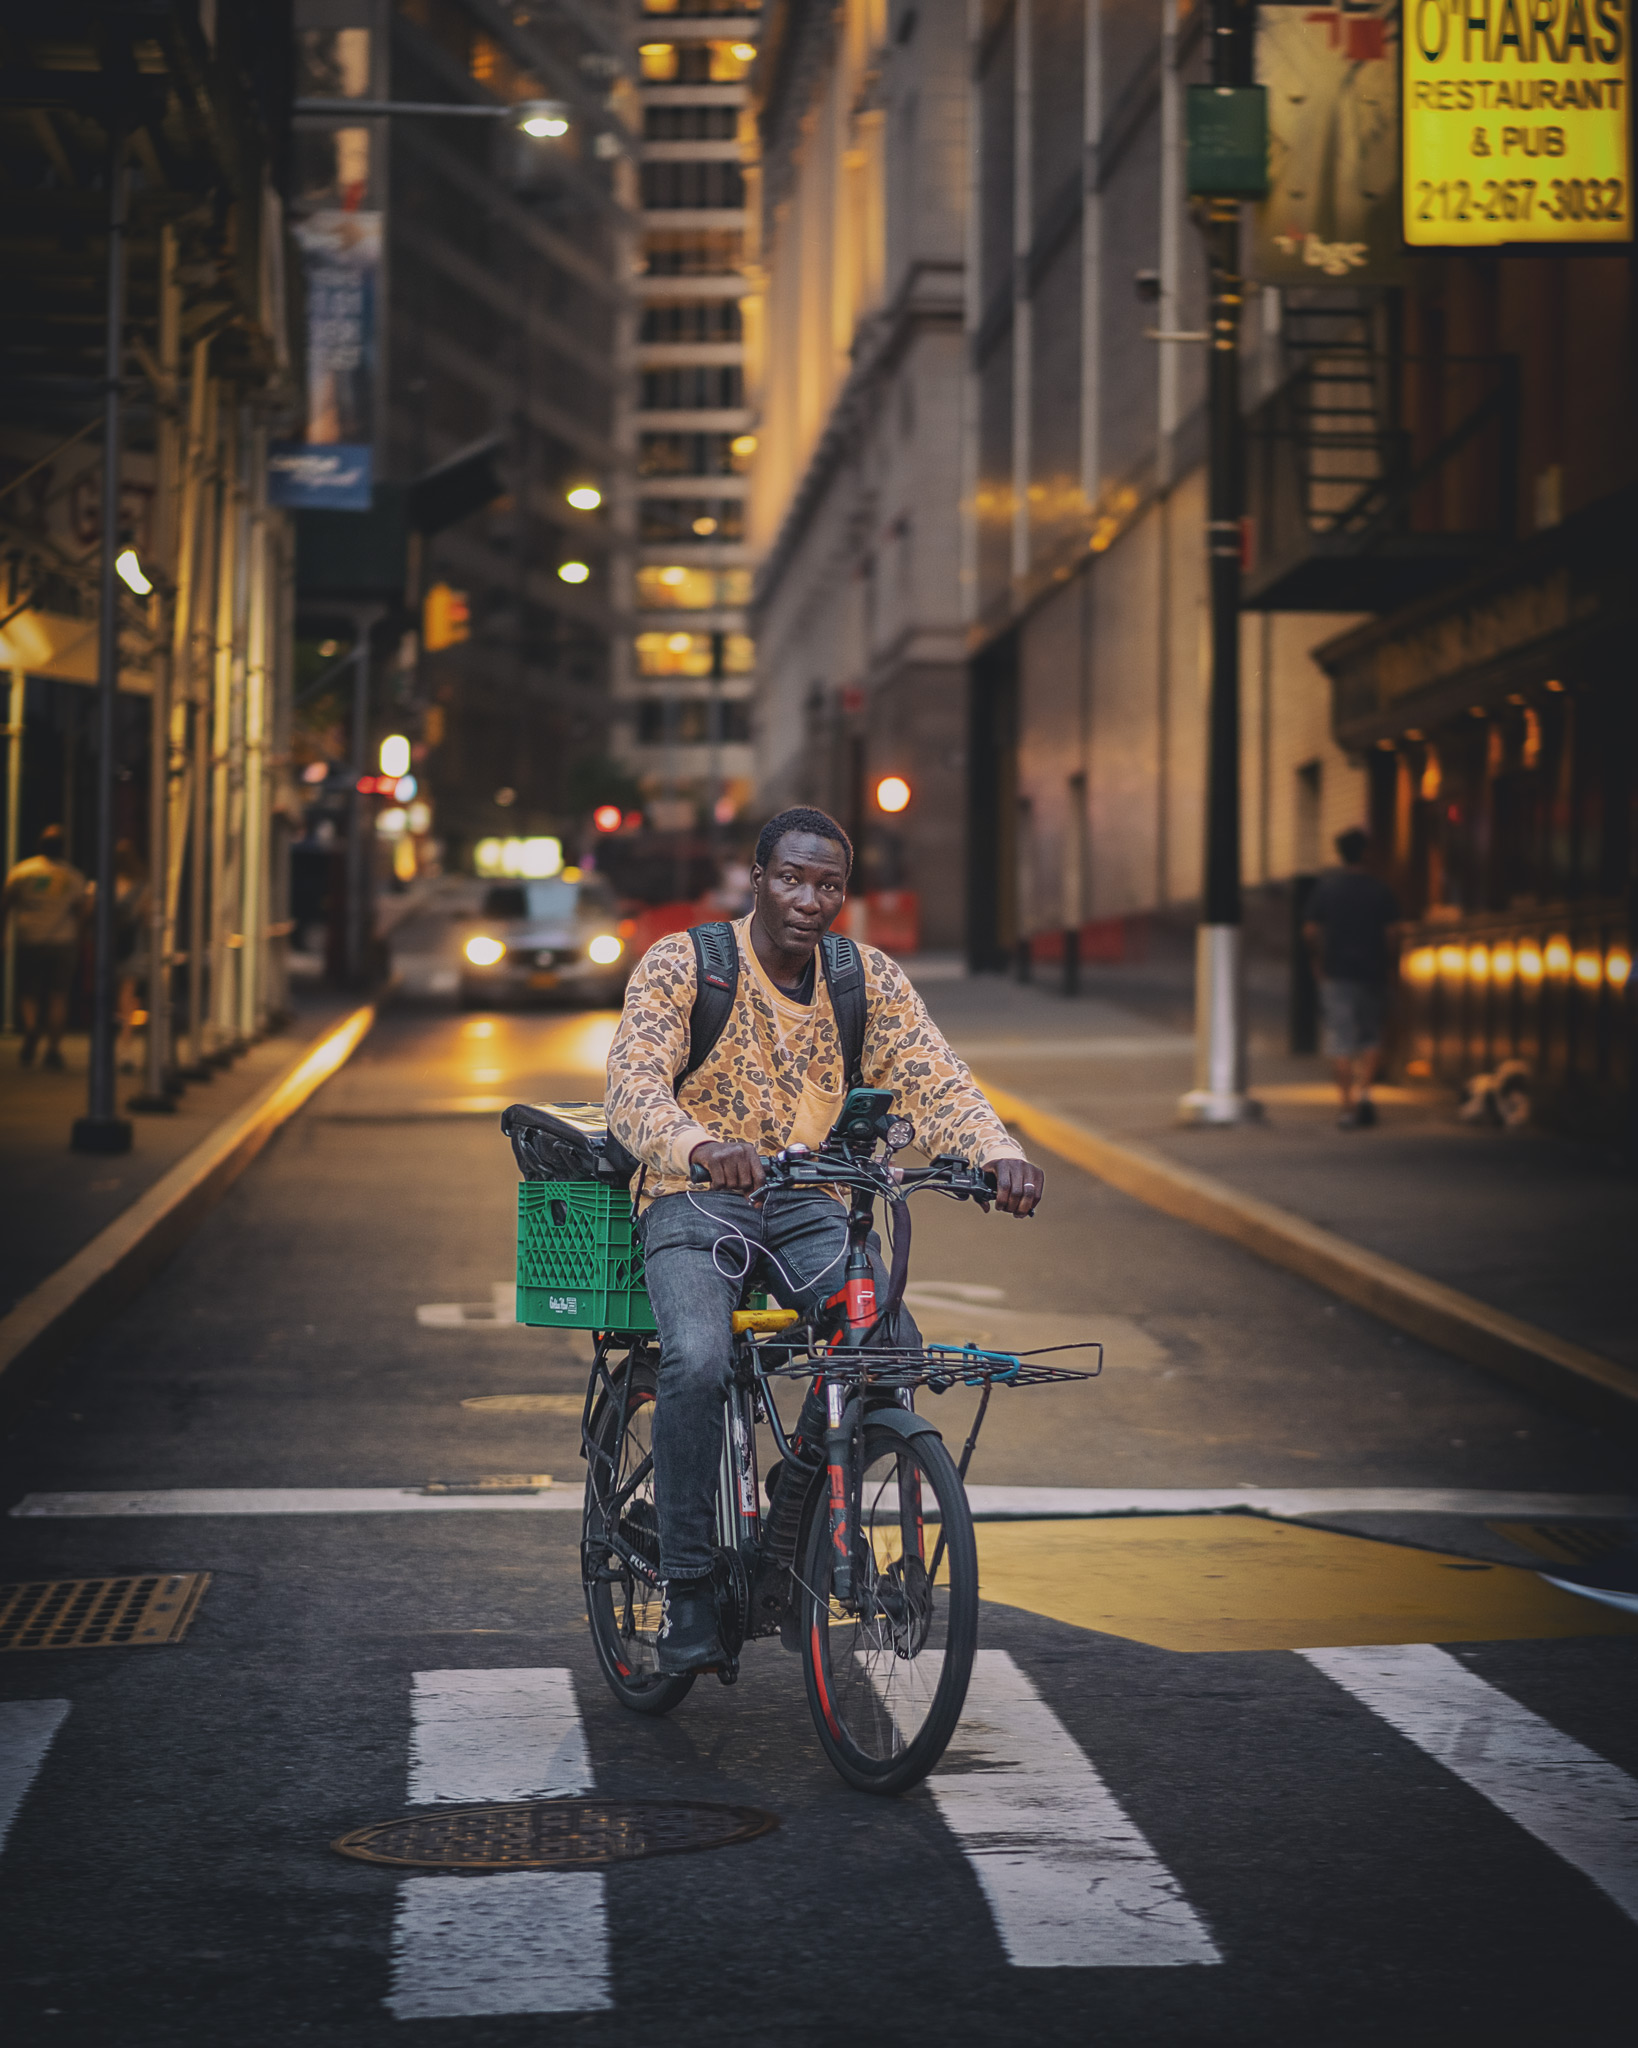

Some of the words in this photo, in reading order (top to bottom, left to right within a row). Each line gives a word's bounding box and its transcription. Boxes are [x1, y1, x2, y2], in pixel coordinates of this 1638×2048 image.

[1415, 0, 1623, 64] O'HARAS
[1413, 78, 1624, 111] RESTAURANT
[1471, 126, 1492, 157] &
[1502, 126, 1567, 157] PUB
[1415, 177, 1624, 222] 212-267-3032
